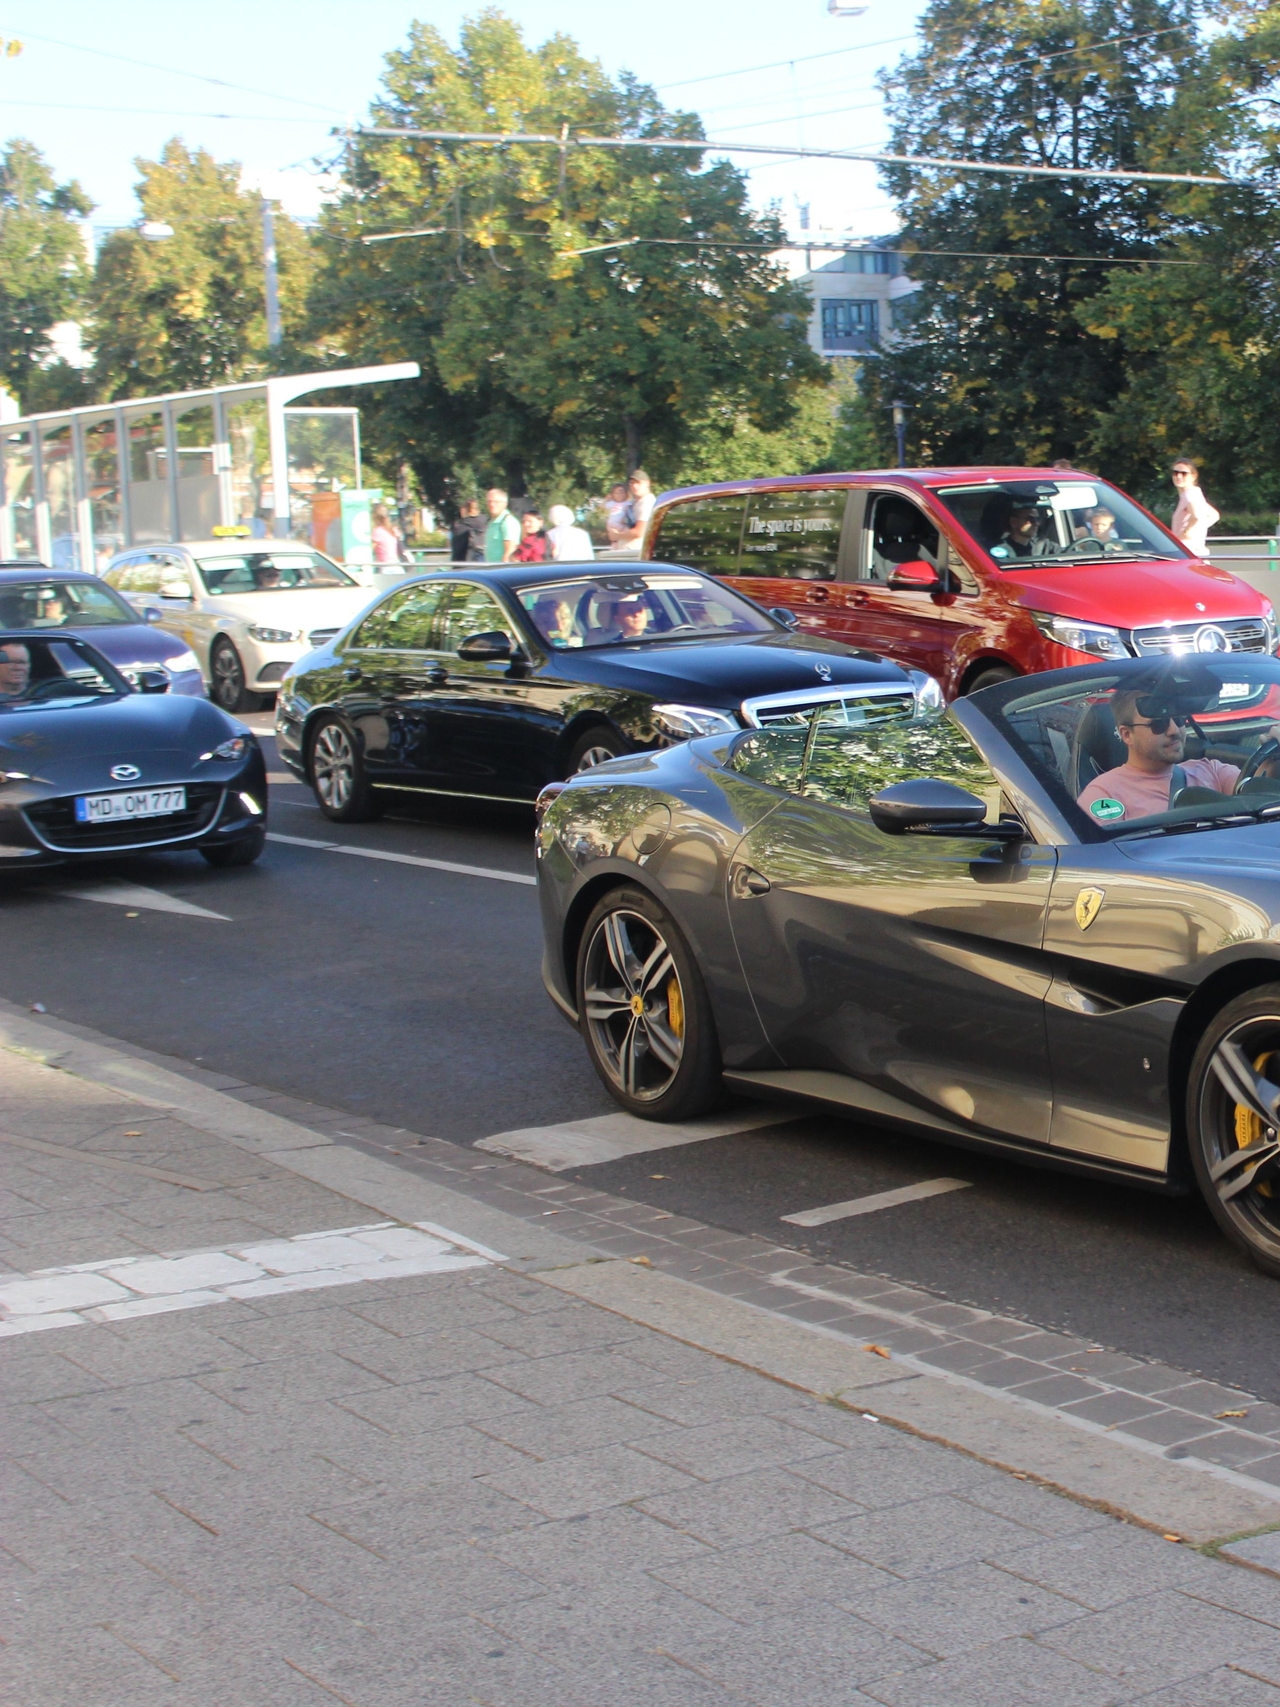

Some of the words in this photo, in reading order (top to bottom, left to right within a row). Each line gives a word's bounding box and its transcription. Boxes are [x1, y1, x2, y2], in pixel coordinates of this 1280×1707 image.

[748, 516, 766, 533] The
[793, 516, 802, 531] is
[88, 799, 112, 817] MD
[124, 796, 148, 813] OM
[152, 790, 183, 810] 777
